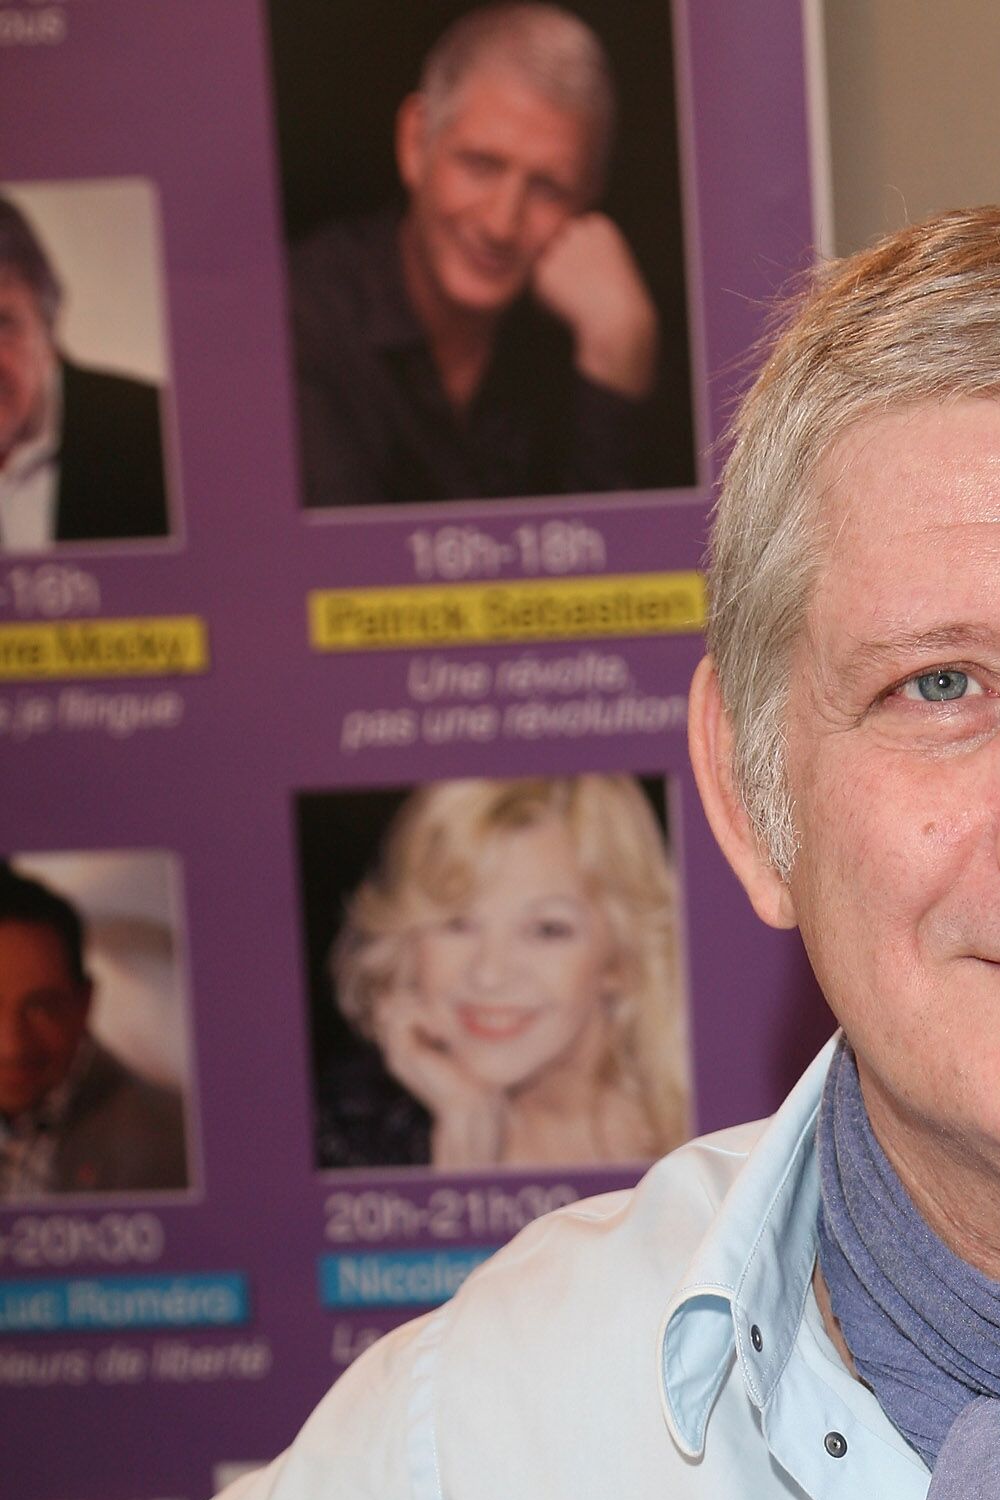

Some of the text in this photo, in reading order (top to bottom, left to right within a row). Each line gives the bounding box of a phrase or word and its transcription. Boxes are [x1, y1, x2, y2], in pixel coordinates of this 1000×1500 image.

[408, 520, 606, 580] 16h-18h
[325, 588, 696, 636] Patrick Sébastien
[408, 657, 492, 702] Une
[341, 709, 417, 754] pas
[422, 706, 497, 742] une
